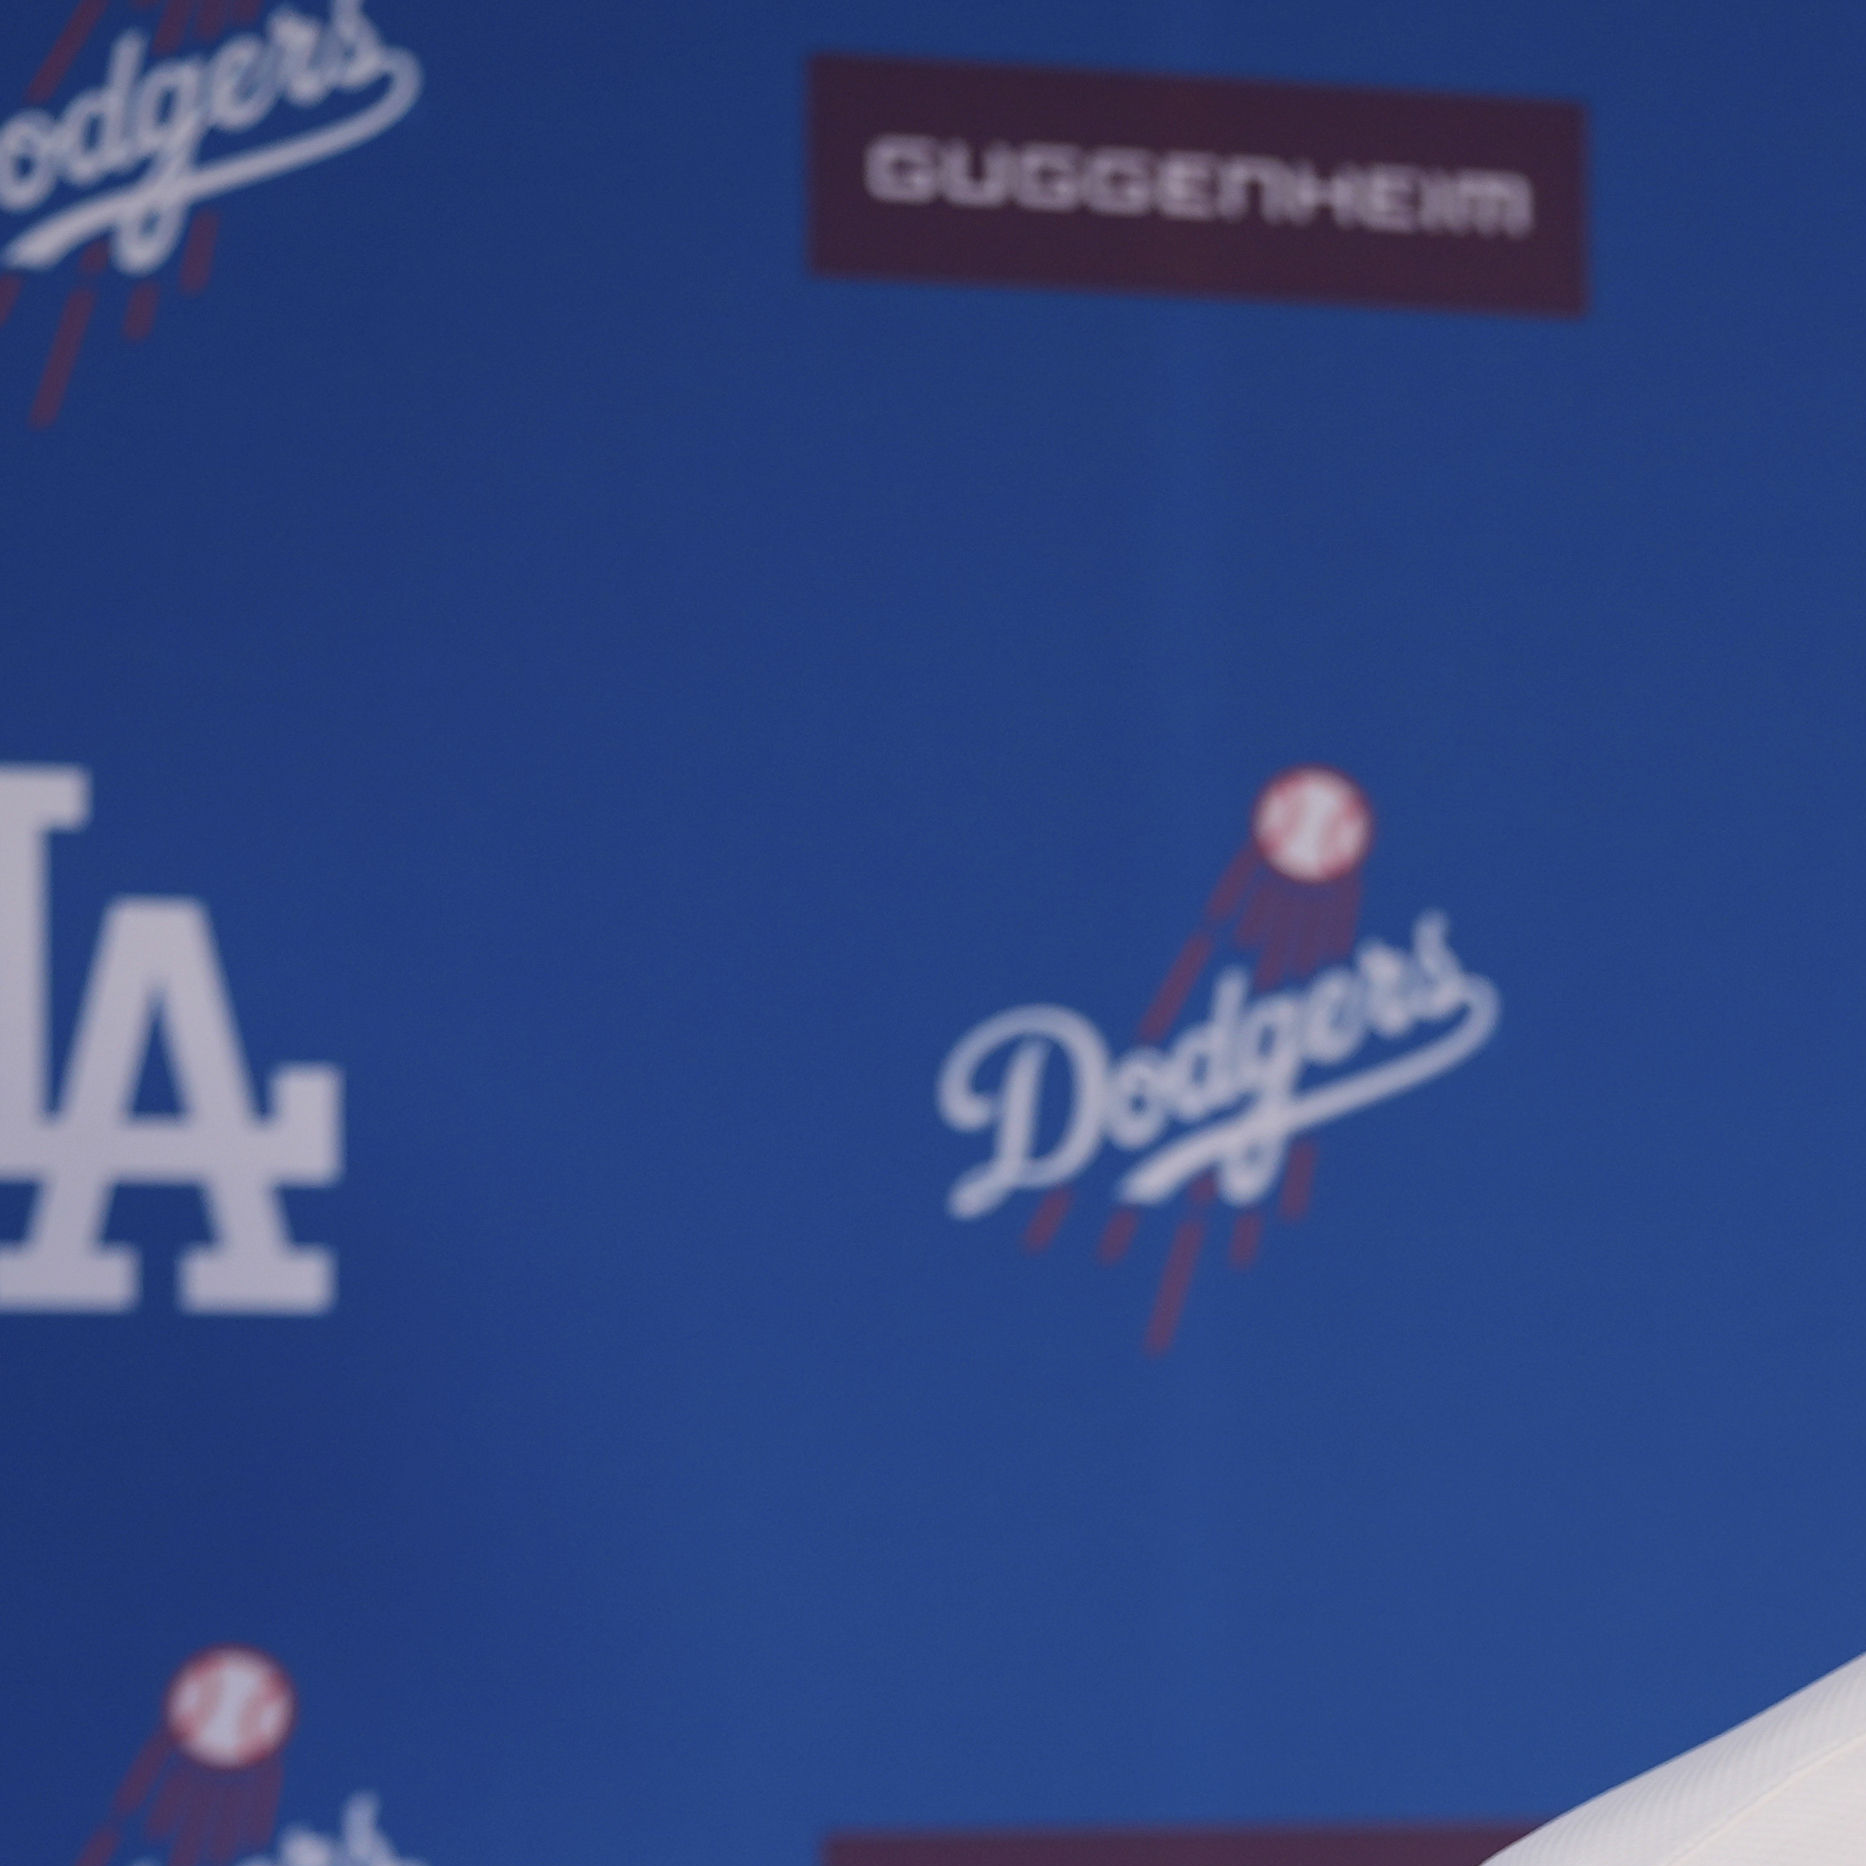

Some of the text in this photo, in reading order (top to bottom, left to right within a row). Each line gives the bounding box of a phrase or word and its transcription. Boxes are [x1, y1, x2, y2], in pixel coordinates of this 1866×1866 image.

[0, 0, 423, 276] odgers
[863, 134, 1536, 238] GUGGENHEIM
[936, 912, 1501, 1220] Dodgers
